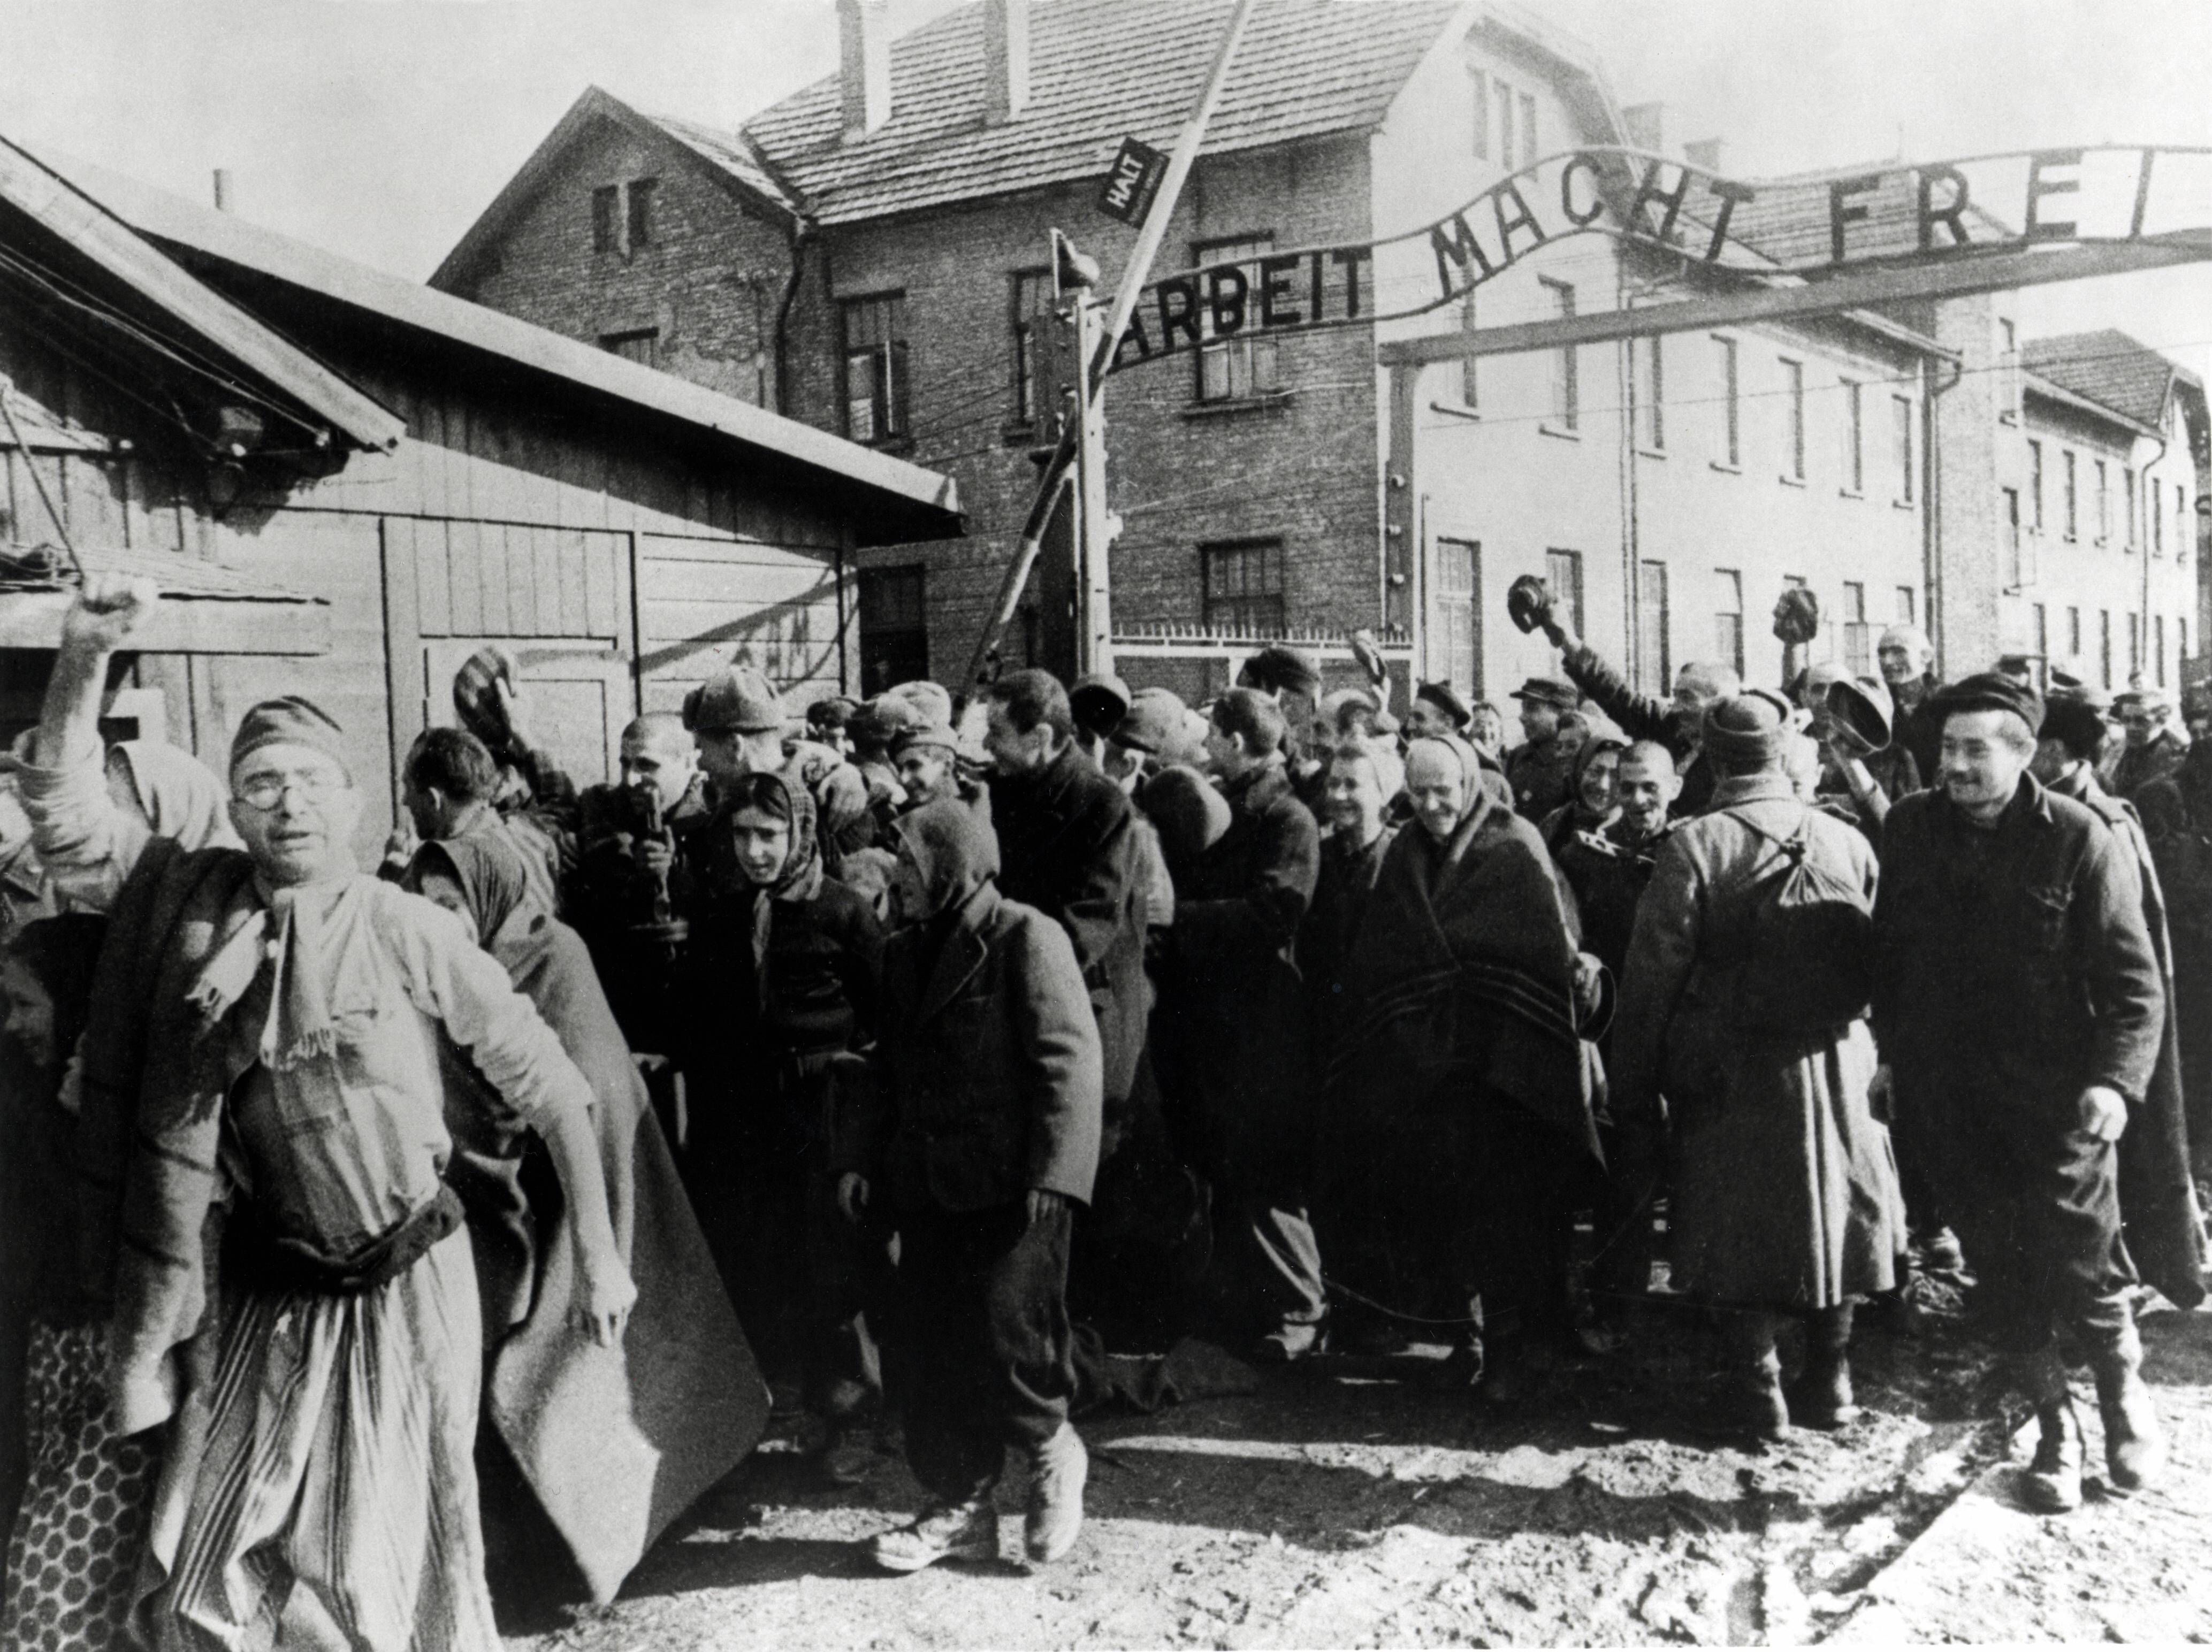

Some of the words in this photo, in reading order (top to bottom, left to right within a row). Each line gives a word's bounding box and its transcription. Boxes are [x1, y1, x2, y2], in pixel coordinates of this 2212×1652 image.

[1106, 153, 1144, 208] HALT
[1109, 247, 1372, 372] ARBEIT
[1430, 152, 1755, 299] MACHT
[1829, 147, 2155, 264] FREI
